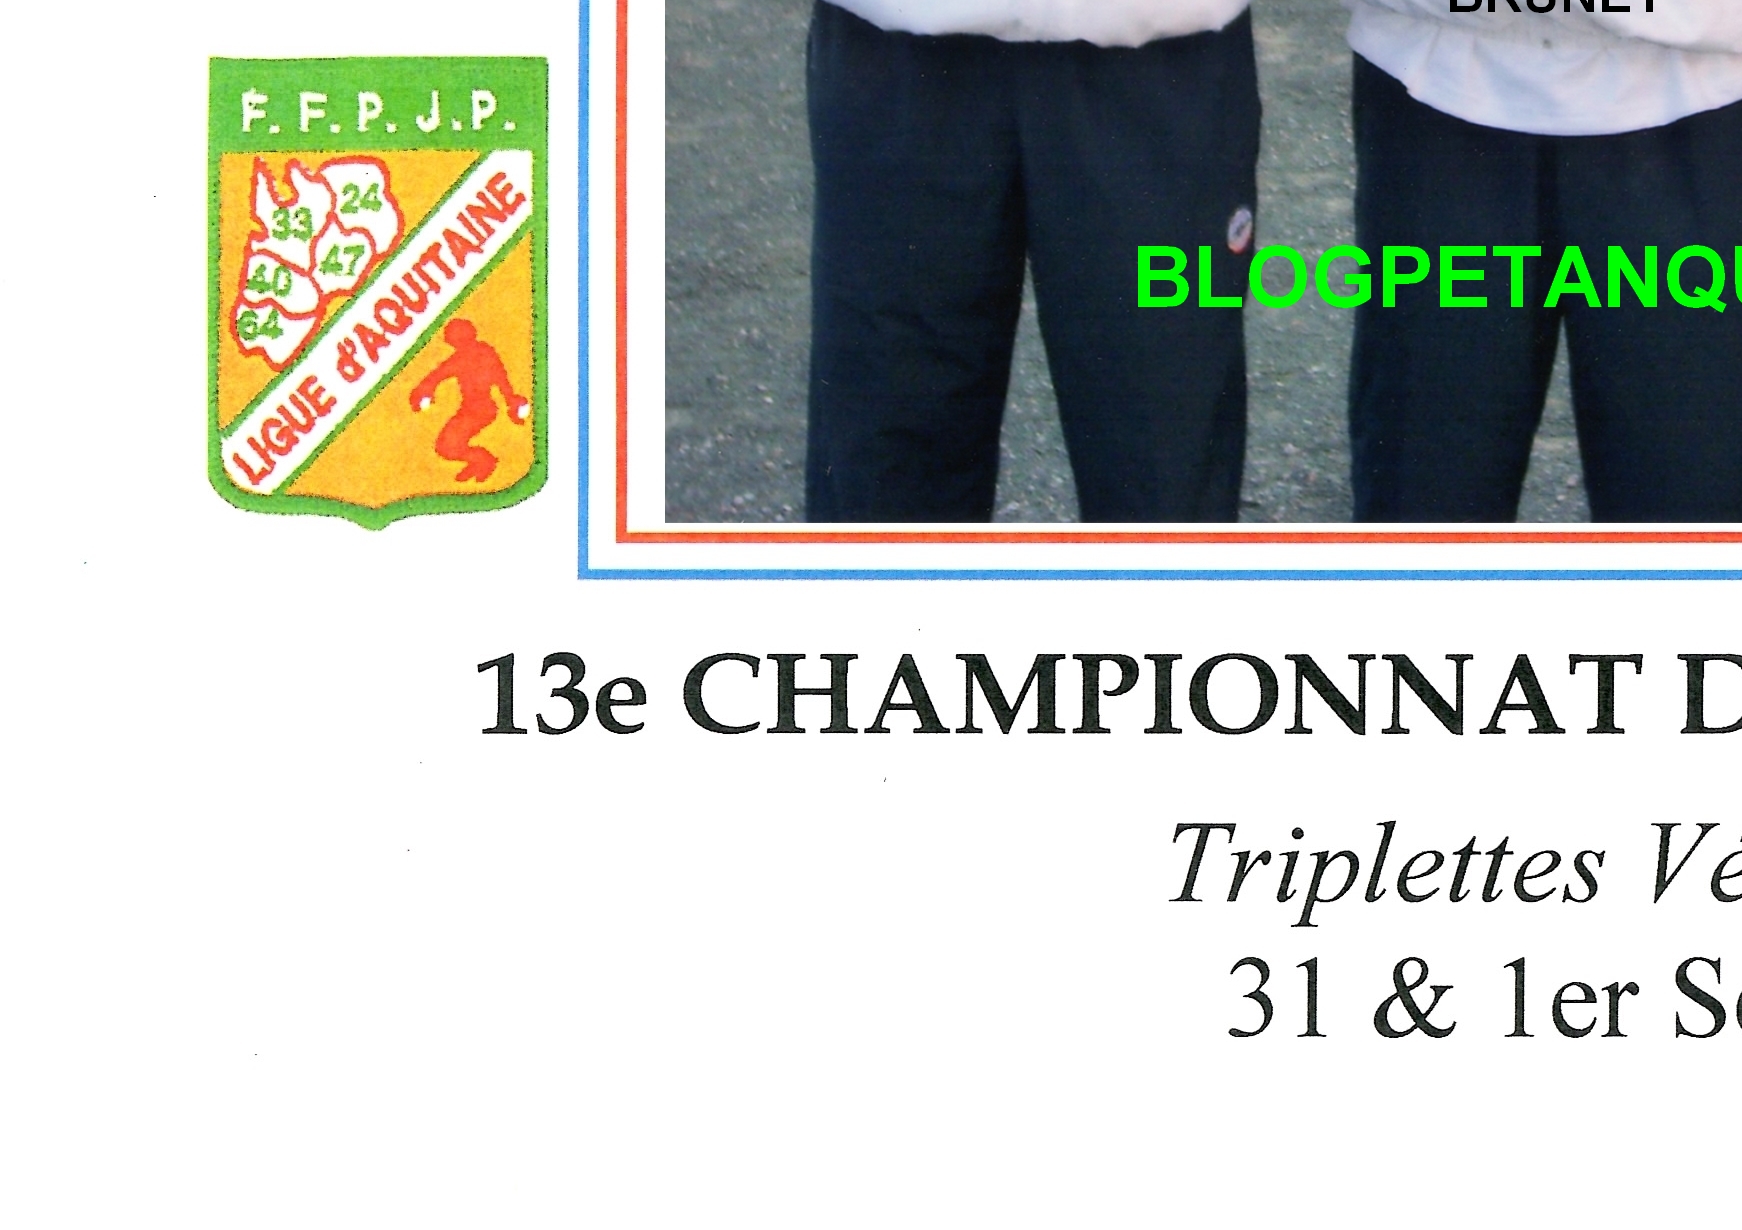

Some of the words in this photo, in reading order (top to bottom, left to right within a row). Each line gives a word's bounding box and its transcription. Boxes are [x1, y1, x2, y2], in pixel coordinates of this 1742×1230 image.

[342, 182, 382, 215] 24
[271, 206, 313, 242] 33
[320, 244, 365, 278] 47
[247, 264, 292, 299] 40
[233, 375, 337, 485] LIGUE
[336, 172, 526, 383] d'AQUITAINE
[236, 308, 284, 342] 64
[476, 651, 647, 736] 13e
[682, 652, 1644, 736] CHAMPIONNAT
[1168, 820, 1606, 928] Triplettes
[1228, 956, 1330, 1038] 31
[1373, 956, 1457, 1039] &
[1503, 956, 1640, 1039] 1er
